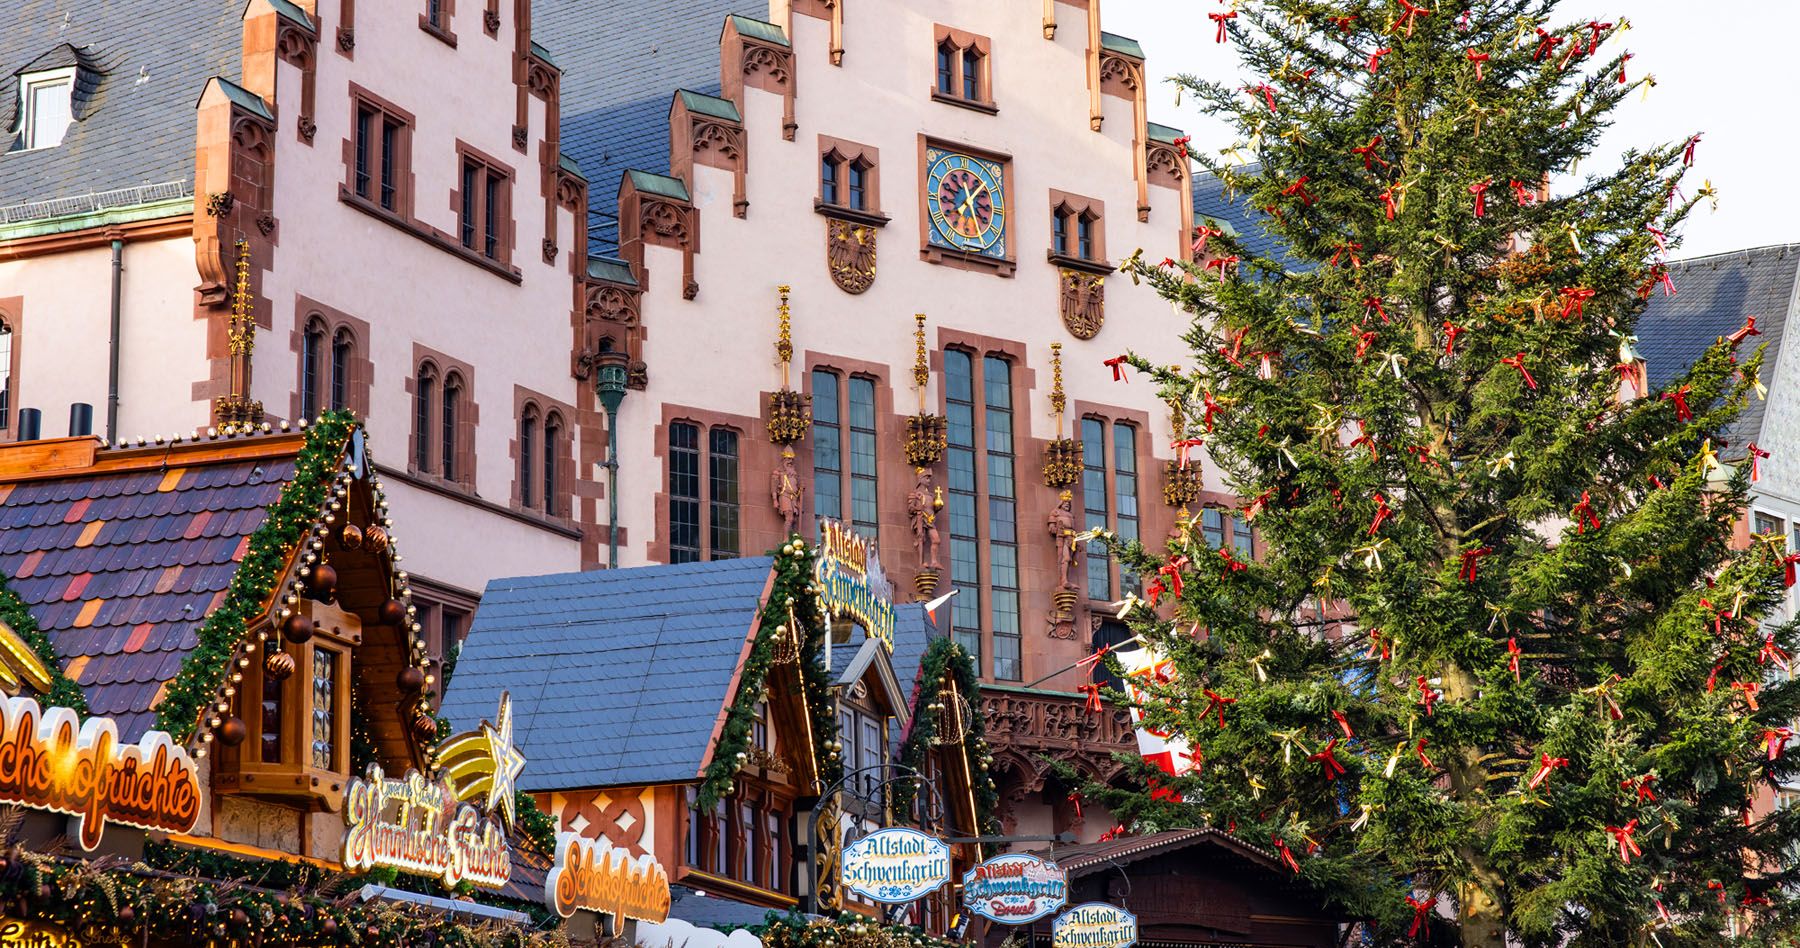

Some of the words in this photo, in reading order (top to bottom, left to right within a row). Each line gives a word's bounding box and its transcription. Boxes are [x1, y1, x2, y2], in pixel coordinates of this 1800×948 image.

[823, 519, 867, 573] Altstadt
[0, 704, 197, 833] chokofrüchte
[862, 836, 925, 858] Altstadt
[844, 857, 948, 887] Schwenkgrill
[975, 862, 1023, 880] Altstadt
[559, 840, 670, 934] Schokofrüchte
[963, 876, 1065, 902] Schwenkgrill
[1069, 909, 1117, 926] Altstadt
[1055, 925, 1133, 948] Schwenkgrill
